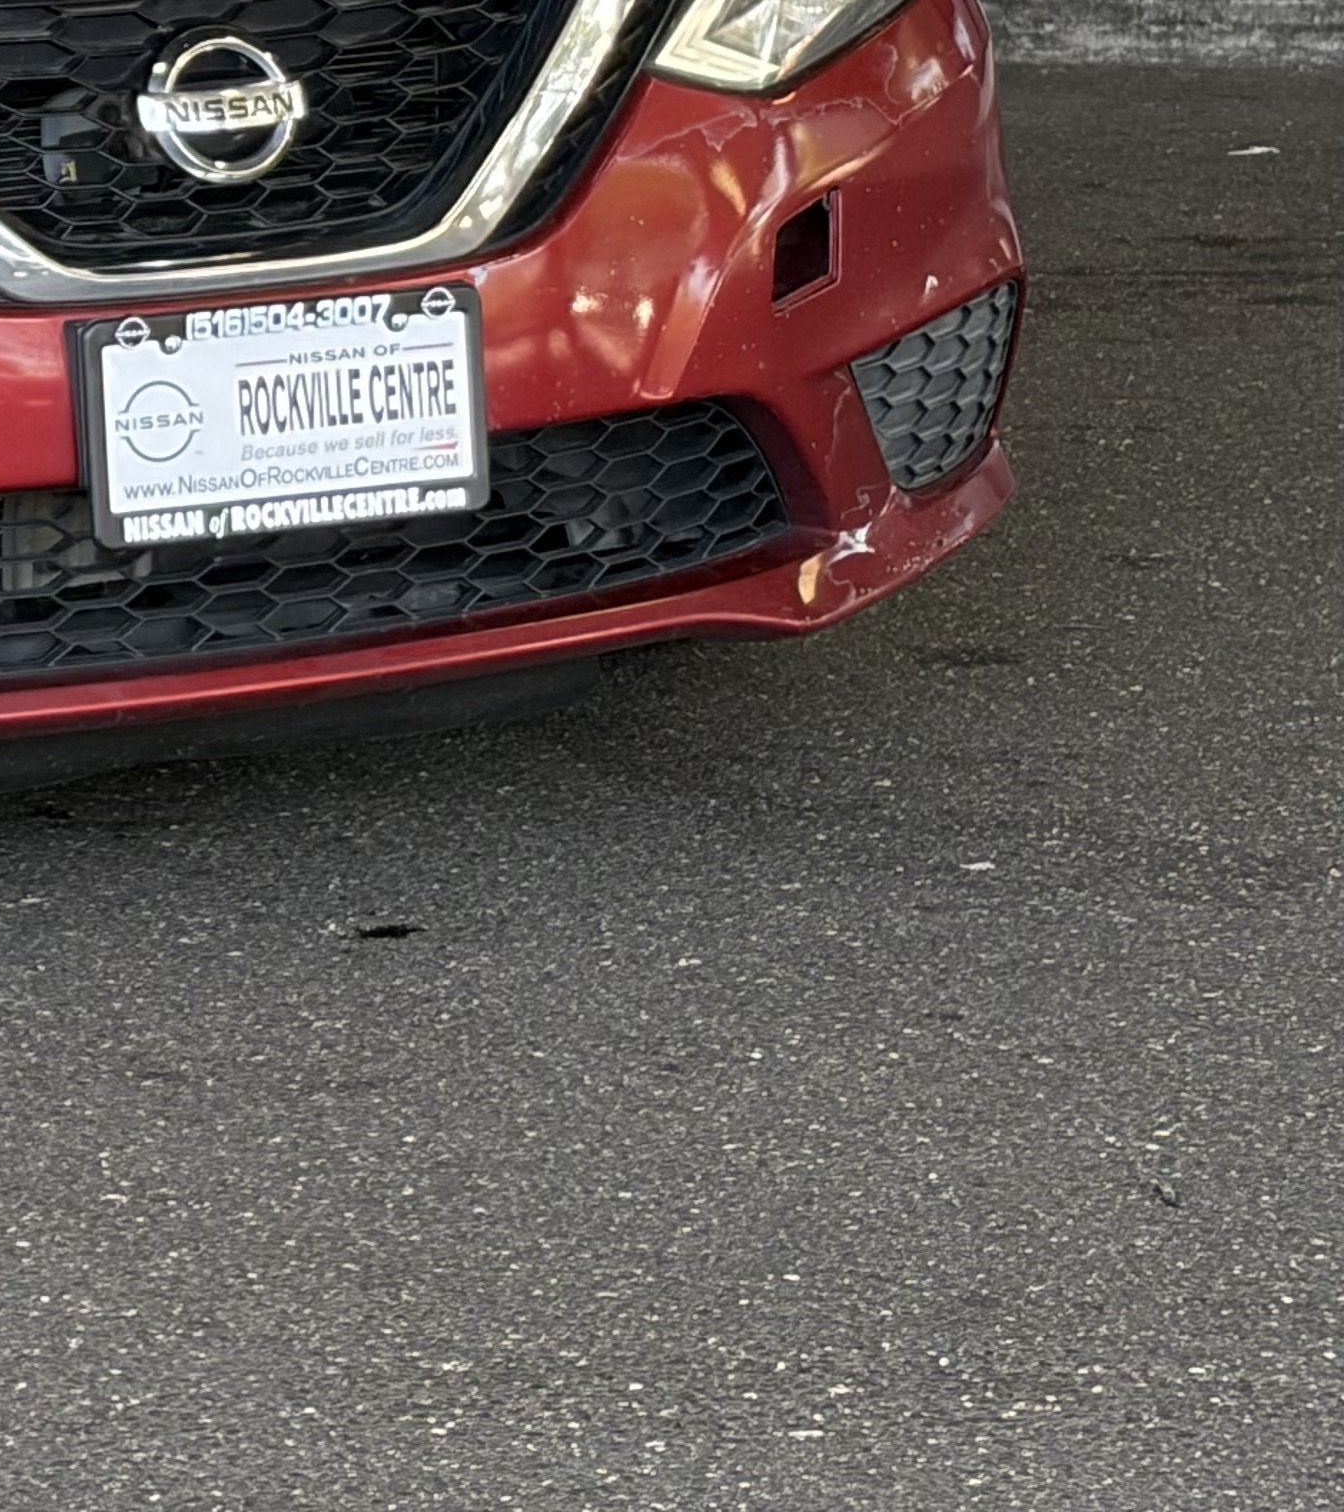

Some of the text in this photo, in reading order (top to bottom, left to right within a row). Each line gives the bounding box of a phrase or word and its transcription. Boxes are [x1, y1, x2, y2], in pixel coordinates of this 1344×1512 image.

[165, 90, 294, 123] NISSAN
[186, 294, 391, 341] (516)504-3007
[288, 343, 401, 365] NISSAN OF
[238, 359, 457, 436] ROCKVILLE CENTRE
[114, 411, 204, 432] NISSAN
[241, 443, 318, 462] Because
[324, 438, 349, 452] we
[355, 430, 385, 447] sell
[390, 428, 415, 445] for
[123, 509, 205, 543] NISSAN
[209, 507, 229, 539] of
